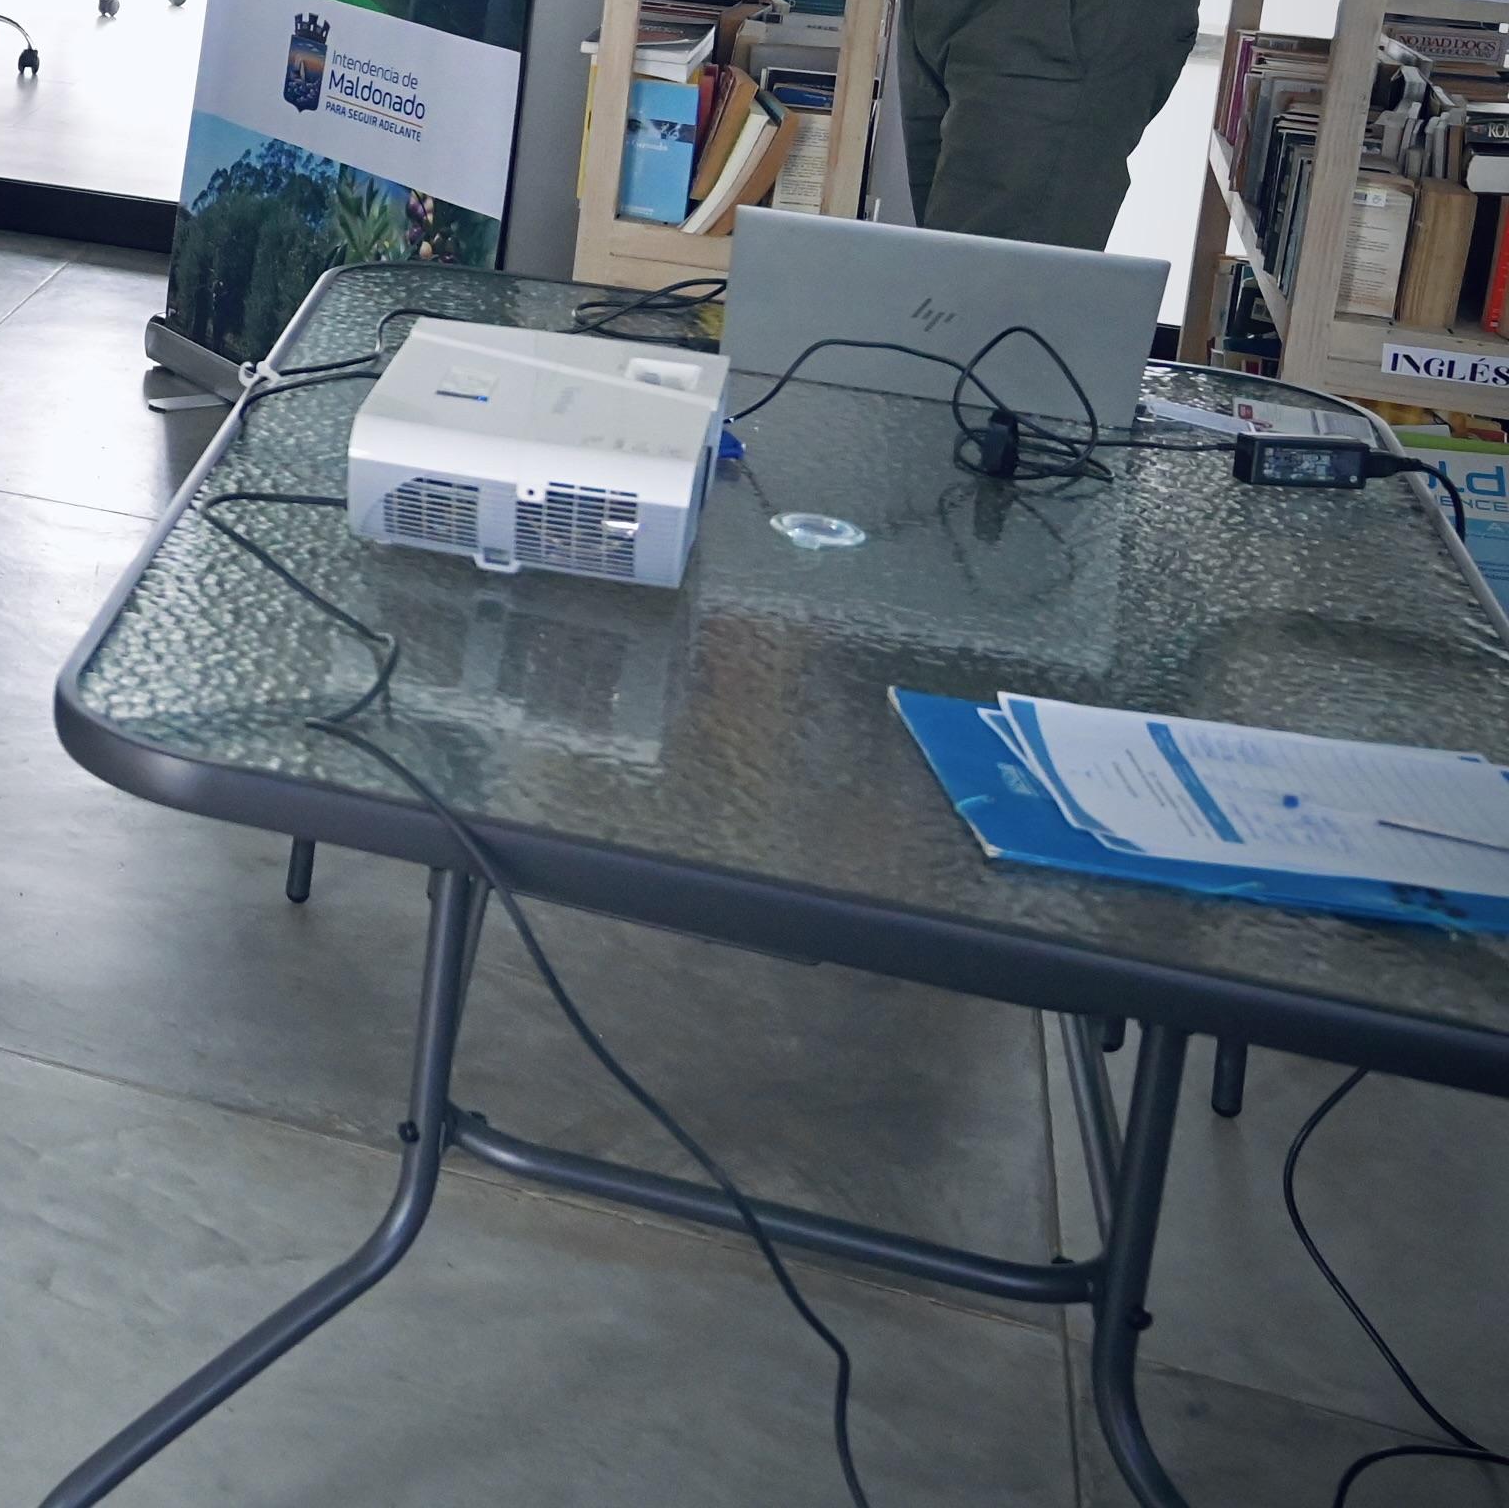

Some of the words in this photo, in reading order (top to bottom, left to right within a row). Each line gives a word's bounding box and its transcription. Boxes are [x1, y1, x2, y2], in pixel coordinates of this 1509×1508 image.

[1421, 37, 1451, 48] BAD
[1454, 39, 1496, 51] DOGS
[332, 50, 399, 84] Intendencia
[402, 70, 419, 89] de
[328, 70, 426, 120] Maldonado
[325, 101, 346, 116] PARA
[347, 108, 378, 127] SEGUIR
[379, 118, 421, 142] ADELANTE
